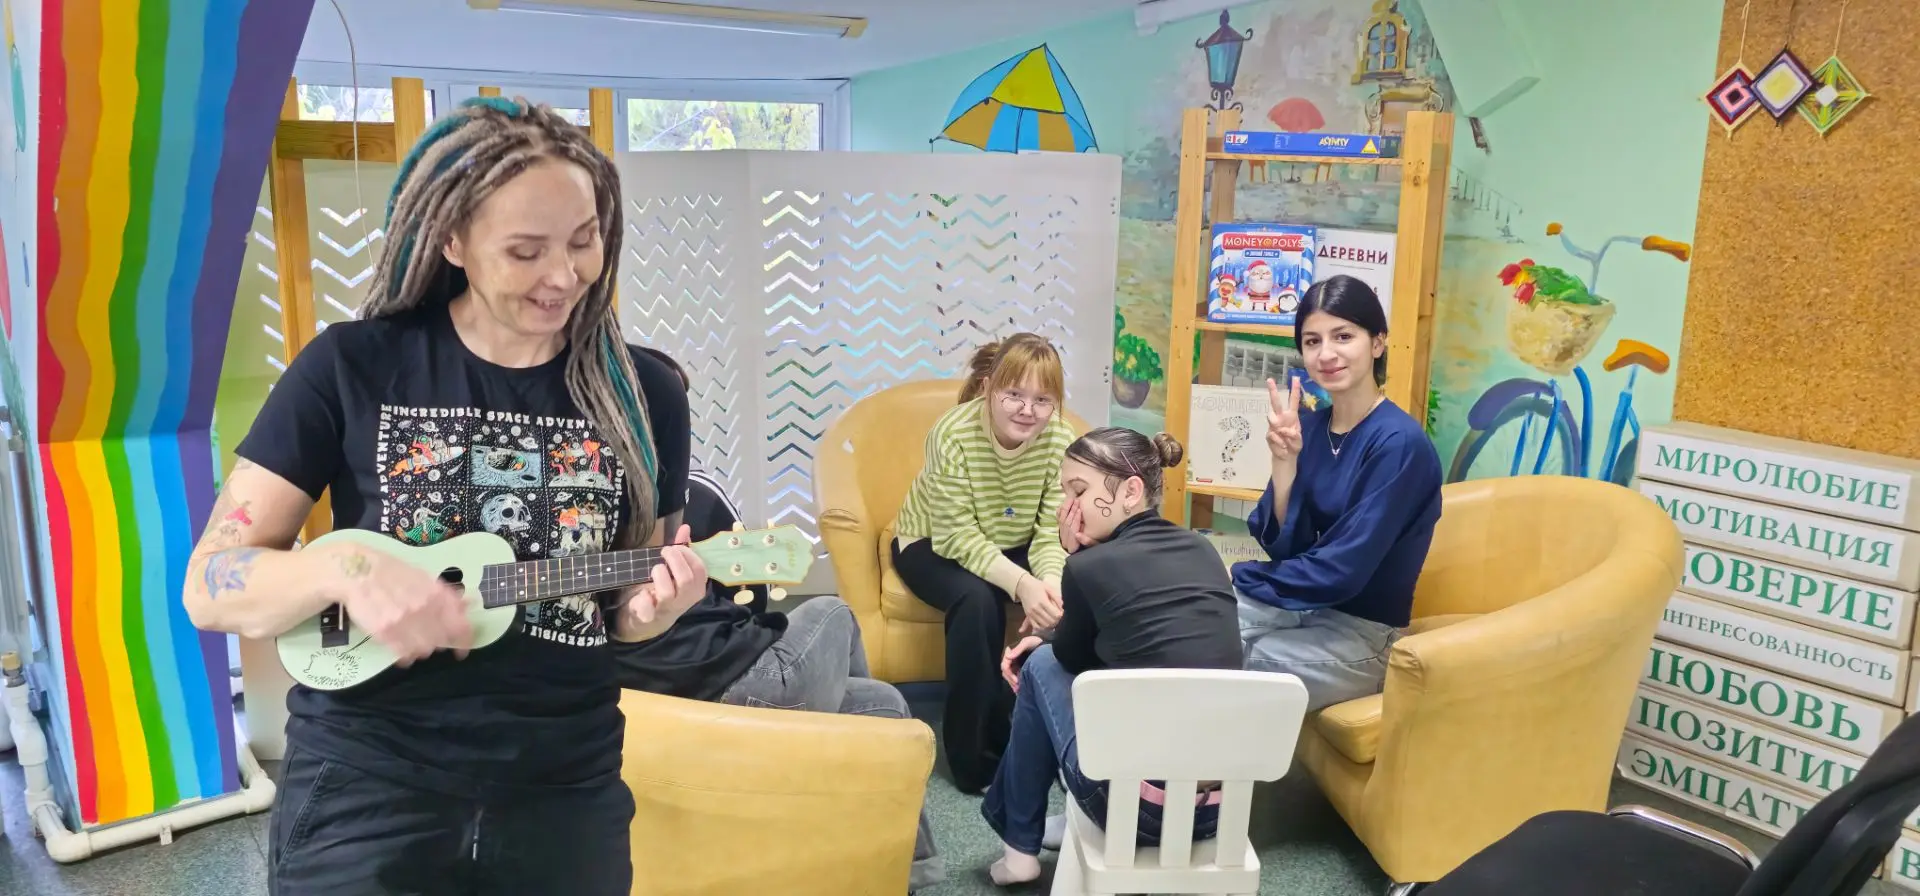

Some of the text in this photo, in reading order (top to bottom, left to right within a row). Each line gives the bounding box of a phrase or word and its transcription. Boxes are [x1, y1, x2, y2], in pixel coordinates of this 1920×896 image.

[1318, 245, 1388, 265] ДЕРЕВНИ
[393, 406, 595, 430] INCREDIBLE SPACE ADVENT
[1192, 395, 1270, 415] КОНЦЕП
[376, 403, 392, 532] PACE ADVENTURE
[1654, 444, 1900, 510] МИРОЛЮБИЕ
[1654, 494, 1894, 569] МОТИВАЦИЯ
[1682, 547, 1894, 631] ОВЕРИЕ
[530, 625, 604, 648] INCREDIBLE
